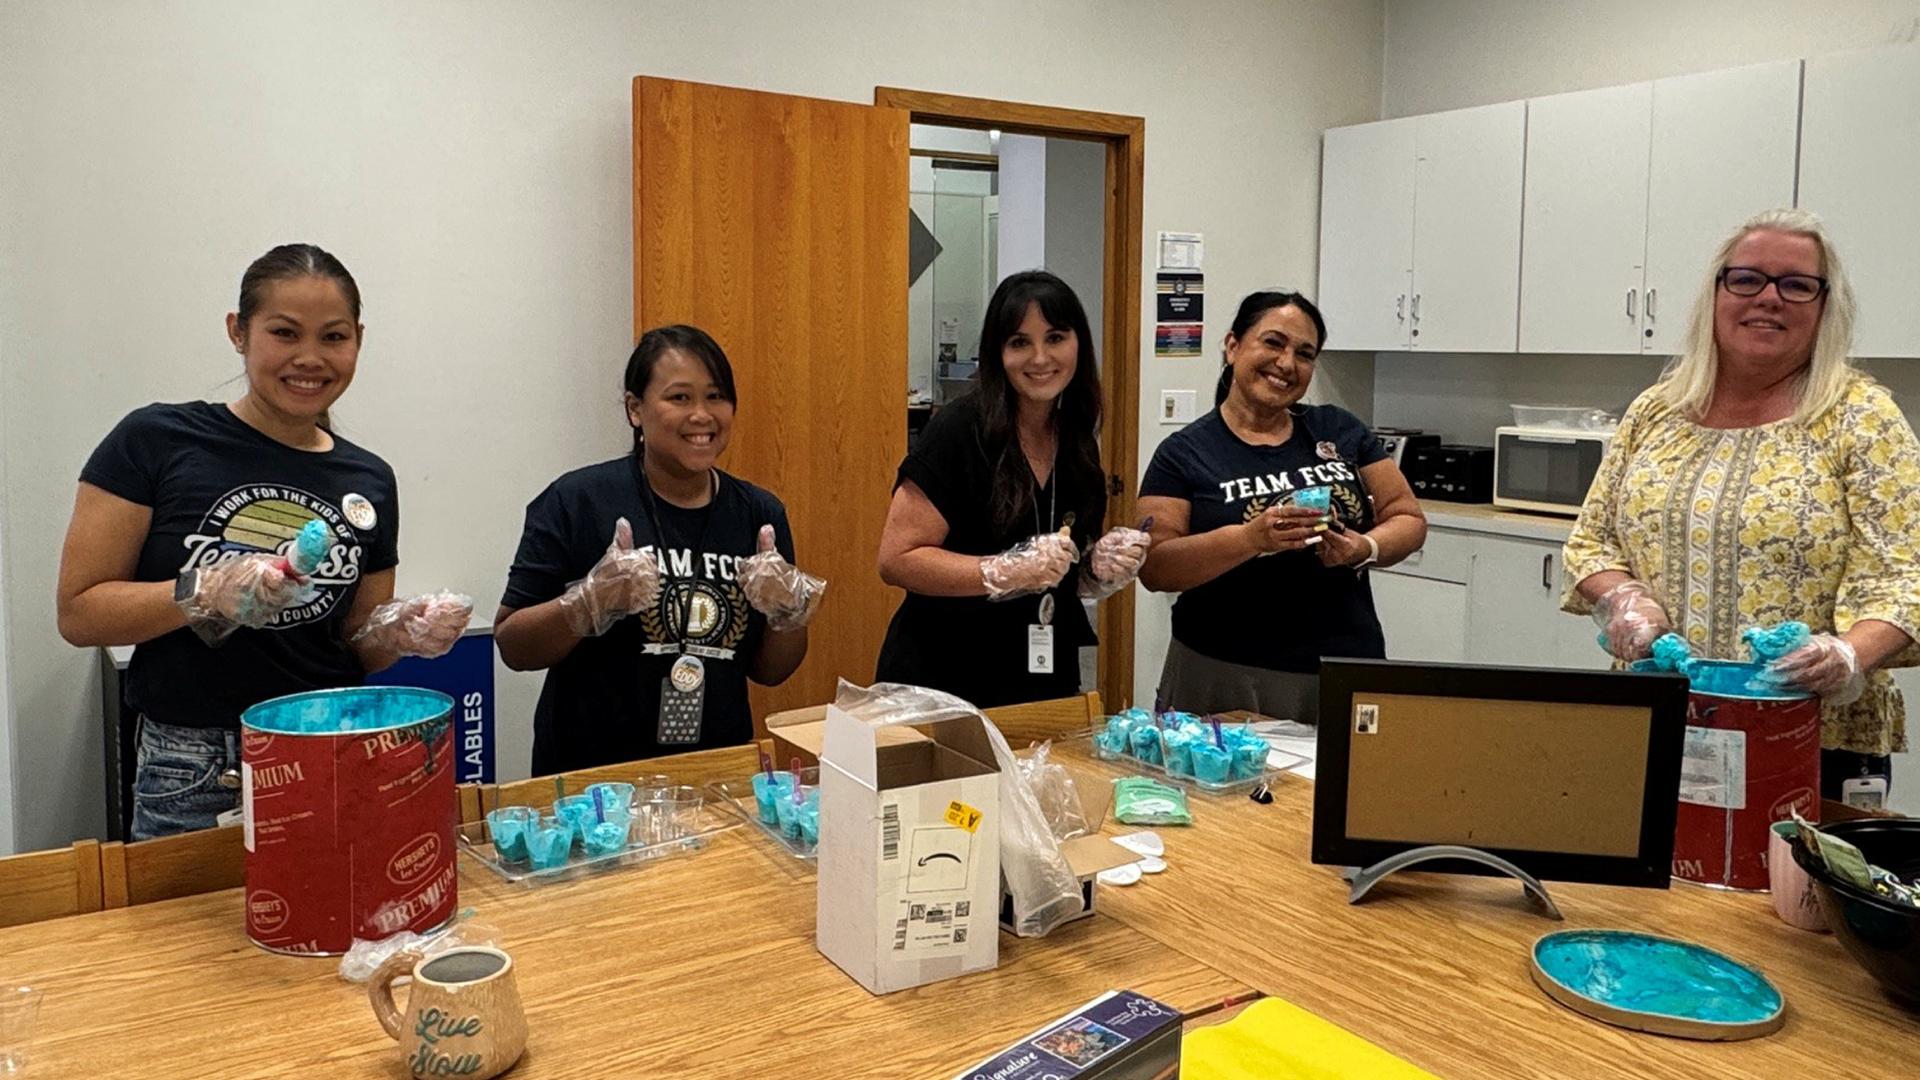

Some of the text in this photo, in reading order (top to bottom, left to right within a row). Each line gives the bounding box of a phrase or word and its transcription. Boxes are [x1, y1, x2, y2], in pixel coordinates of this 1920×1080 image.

[251, 487, 280, 500] FOR
[1219, 461, 1355, 503] TEAM FCSS
[213, 490, 253, 520] WORK
[281, 489, 308, 507] THE
[310, 500, 341, 523] KIDS
[208, 519, 223, 528] I
[335, 523, 353, 538] OF
[179, 534, 362, 585] Tea SS
[639, 545, 743, 581] AM FC
[282, 590, 334, 623] COUNTY
[463, 691, 483, 785] LABLES
[252, 760, 305, 790] MIUM
[415, 1007, 484, 1043] Live
[408, 1041, 484, 1077] Slow
